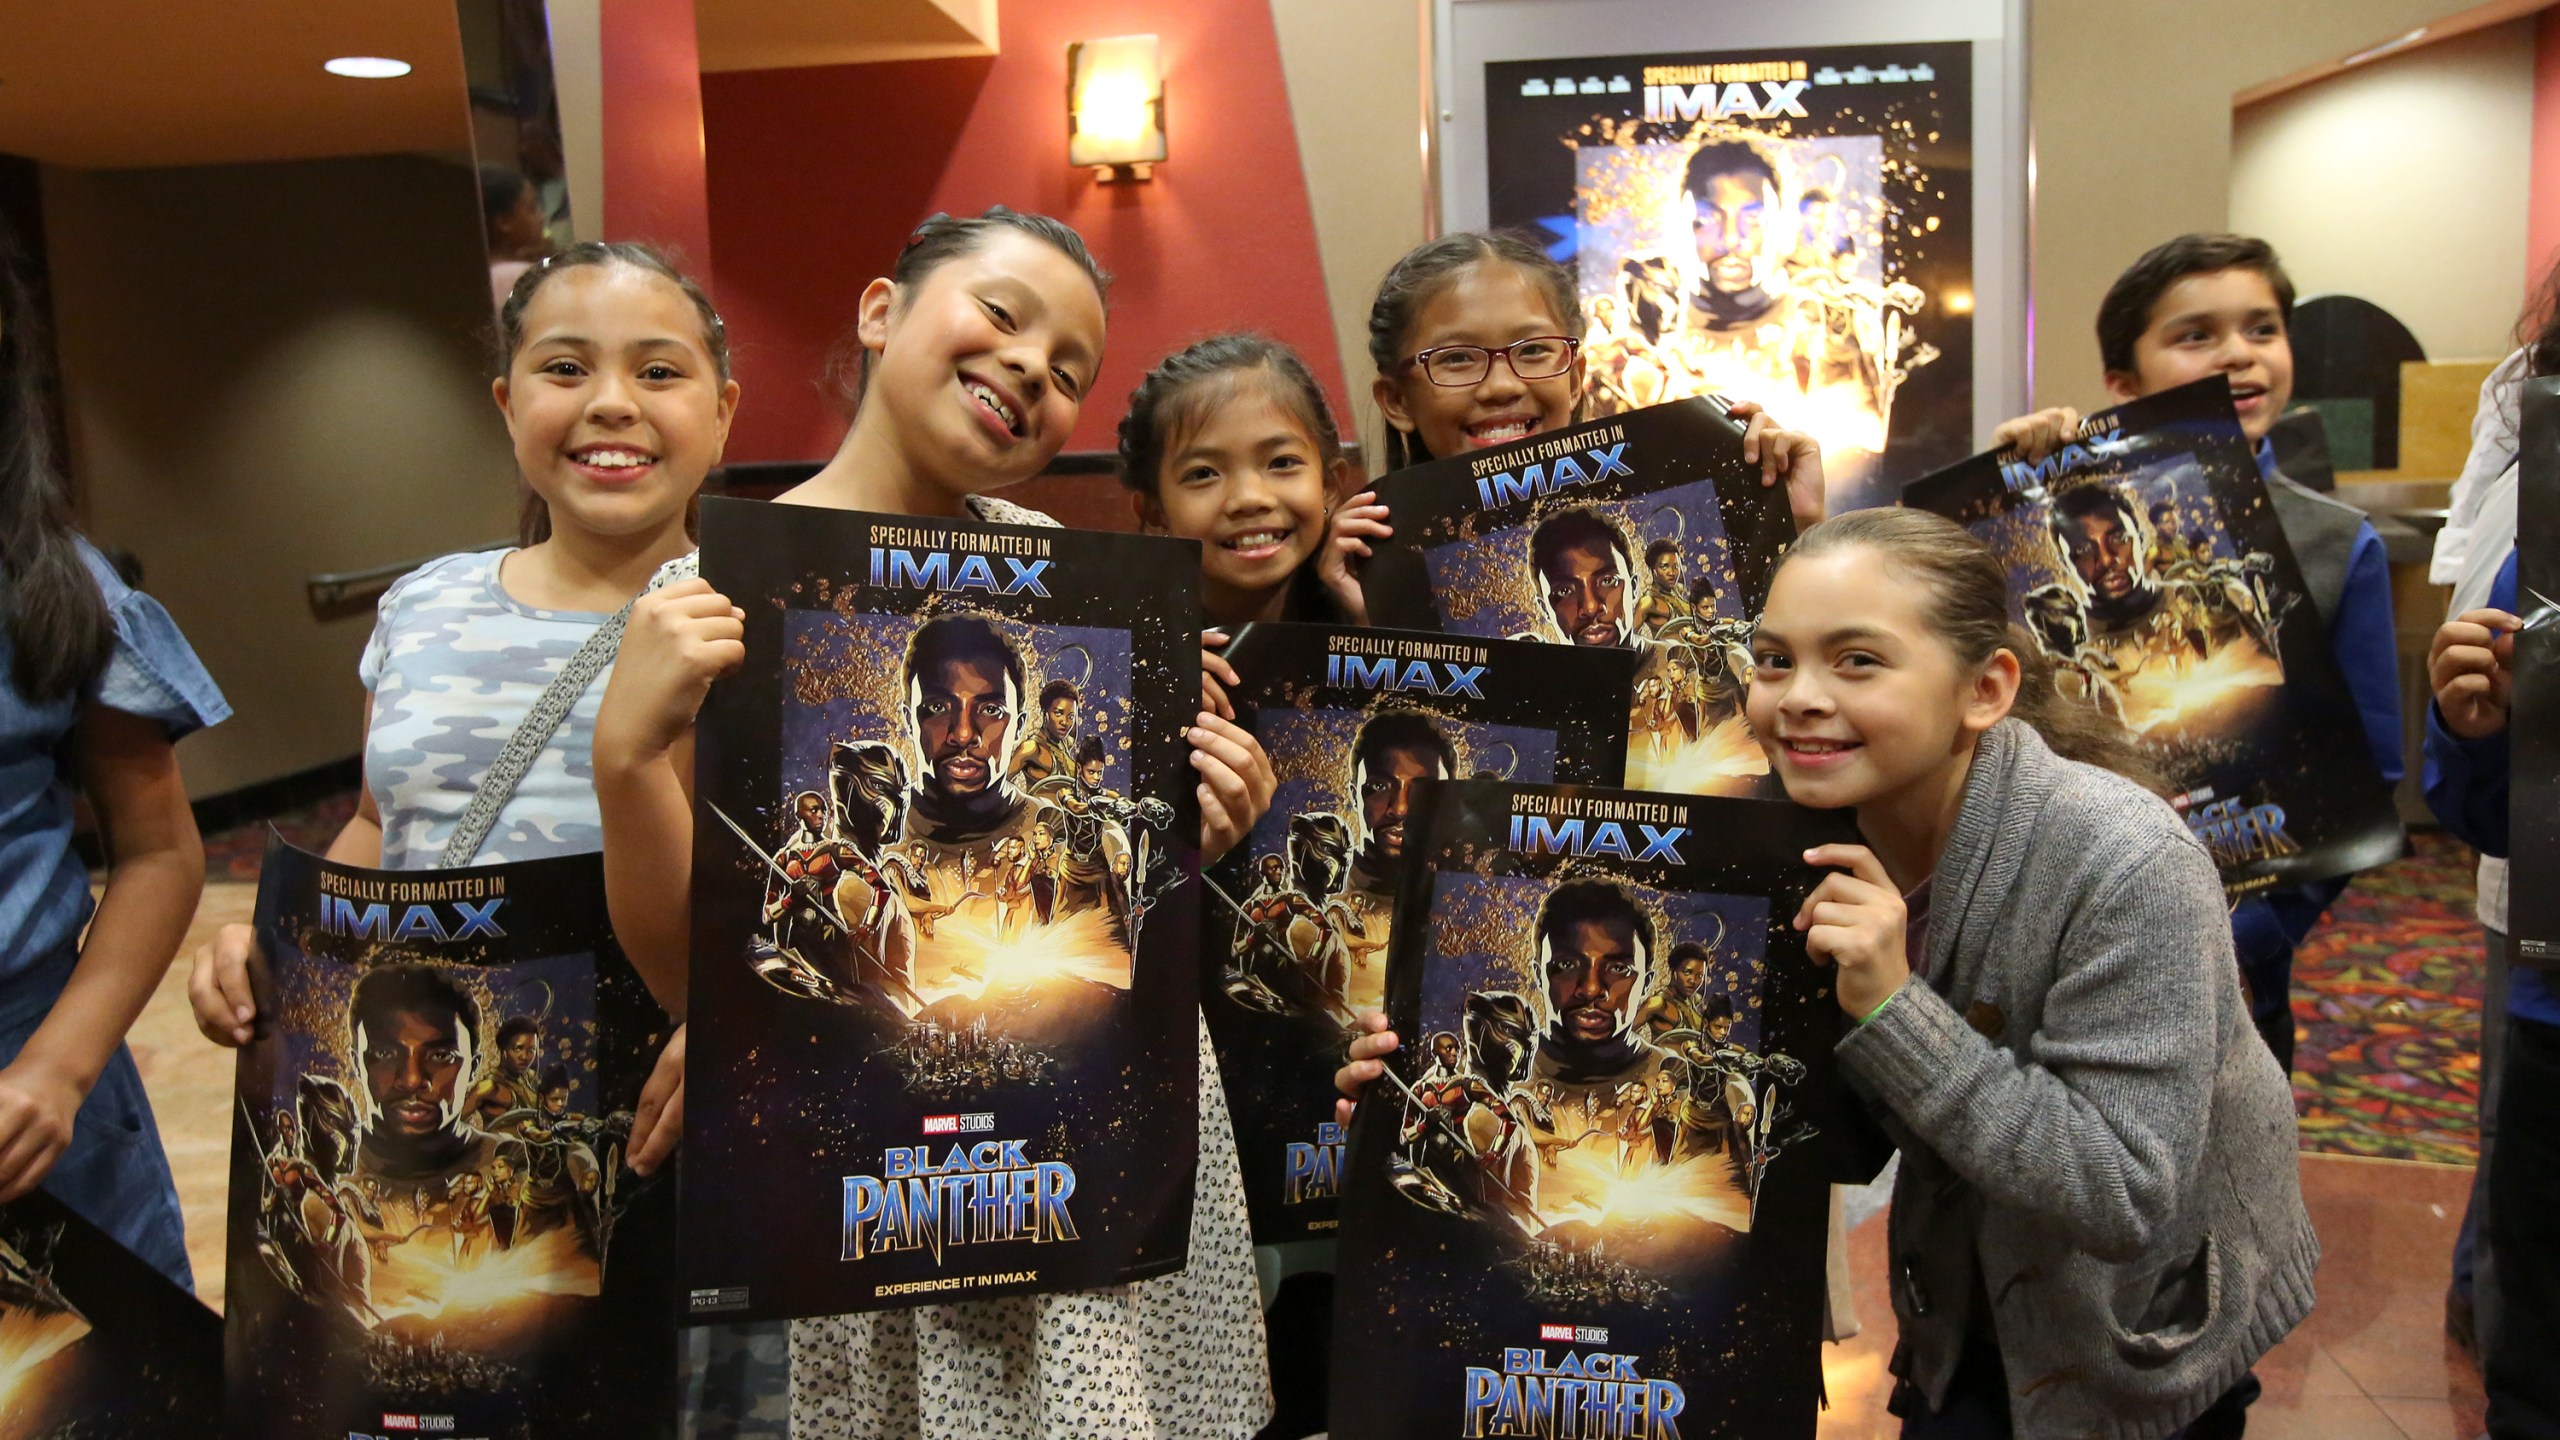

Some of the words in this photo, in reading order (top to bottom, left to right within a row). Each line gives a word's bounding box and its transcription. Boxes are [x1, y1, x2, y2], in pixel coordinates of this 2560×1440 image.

[1643, 65, 1712, 86] SPECIALLY
[1790, 60, 1808, 81] IN
[1643, 80, 1809, 123] IMAX
[1471, 446, 1535, 478] SPECIALLY
[1538, 429, 1609, 460] FORMATTED
[1611, 424, 1625, 442] IN
[1475, 442, 1635, 512] IMAX
[869, 524, 947, 549] SPECIALLY
[951, 531, 1033, 556] FORMATTED
[1037, 538, 1051, 557] IN
[869, 547, 1052, 598] IMAX
[1328, 635, 1395, 656] SPECIALLY
[1398, 641, 1471, 663] FORMATTED
[1474, 647, 1488, 664] IN
[1326, 654, 1486, 700] IMAX
[1511, 793, 1583, 817] SPECIALLY
[1586, 799, 1669, 823] FORMATTED
[1673, 805, 1688, 825] IN
[1508, 815, 1687, 866] IMAX
[320, 871, 385, 901] SPECIALLY
[391, 878, 485, 902] FORMATTED
[489, 876, 505, 895] IN
[320, 892, 508, 944] IMAX
[924, 1115, 959, 1133] MARVEL
[960, 1114, 995, 1131] STUDIOS
[885, 1139, 1032, 1179] BLACK
[840, 1161, 1081, 1267] PANTHER
[692, 1296, 718, 1306] PG-13
[874, 1277, 961, 1298] EXPERIENCE
[962, 1276, 976, 1289] IT
[977, 1275, 993, 1287] IN
[994, 1270, 1038, 1286] IMAX
[1541, 1325, 1574, 1341] MARVEL
[1575, 1327, 1609, 1343] STUDIOS
[1503, 1347, 1643, 1381] BLACK
[1462, 1366, 1686, 1440] PANTHER
[383, 1414, 418, 1429] MARVEL
[419, 1416, 455, 1430] STUDIOS
